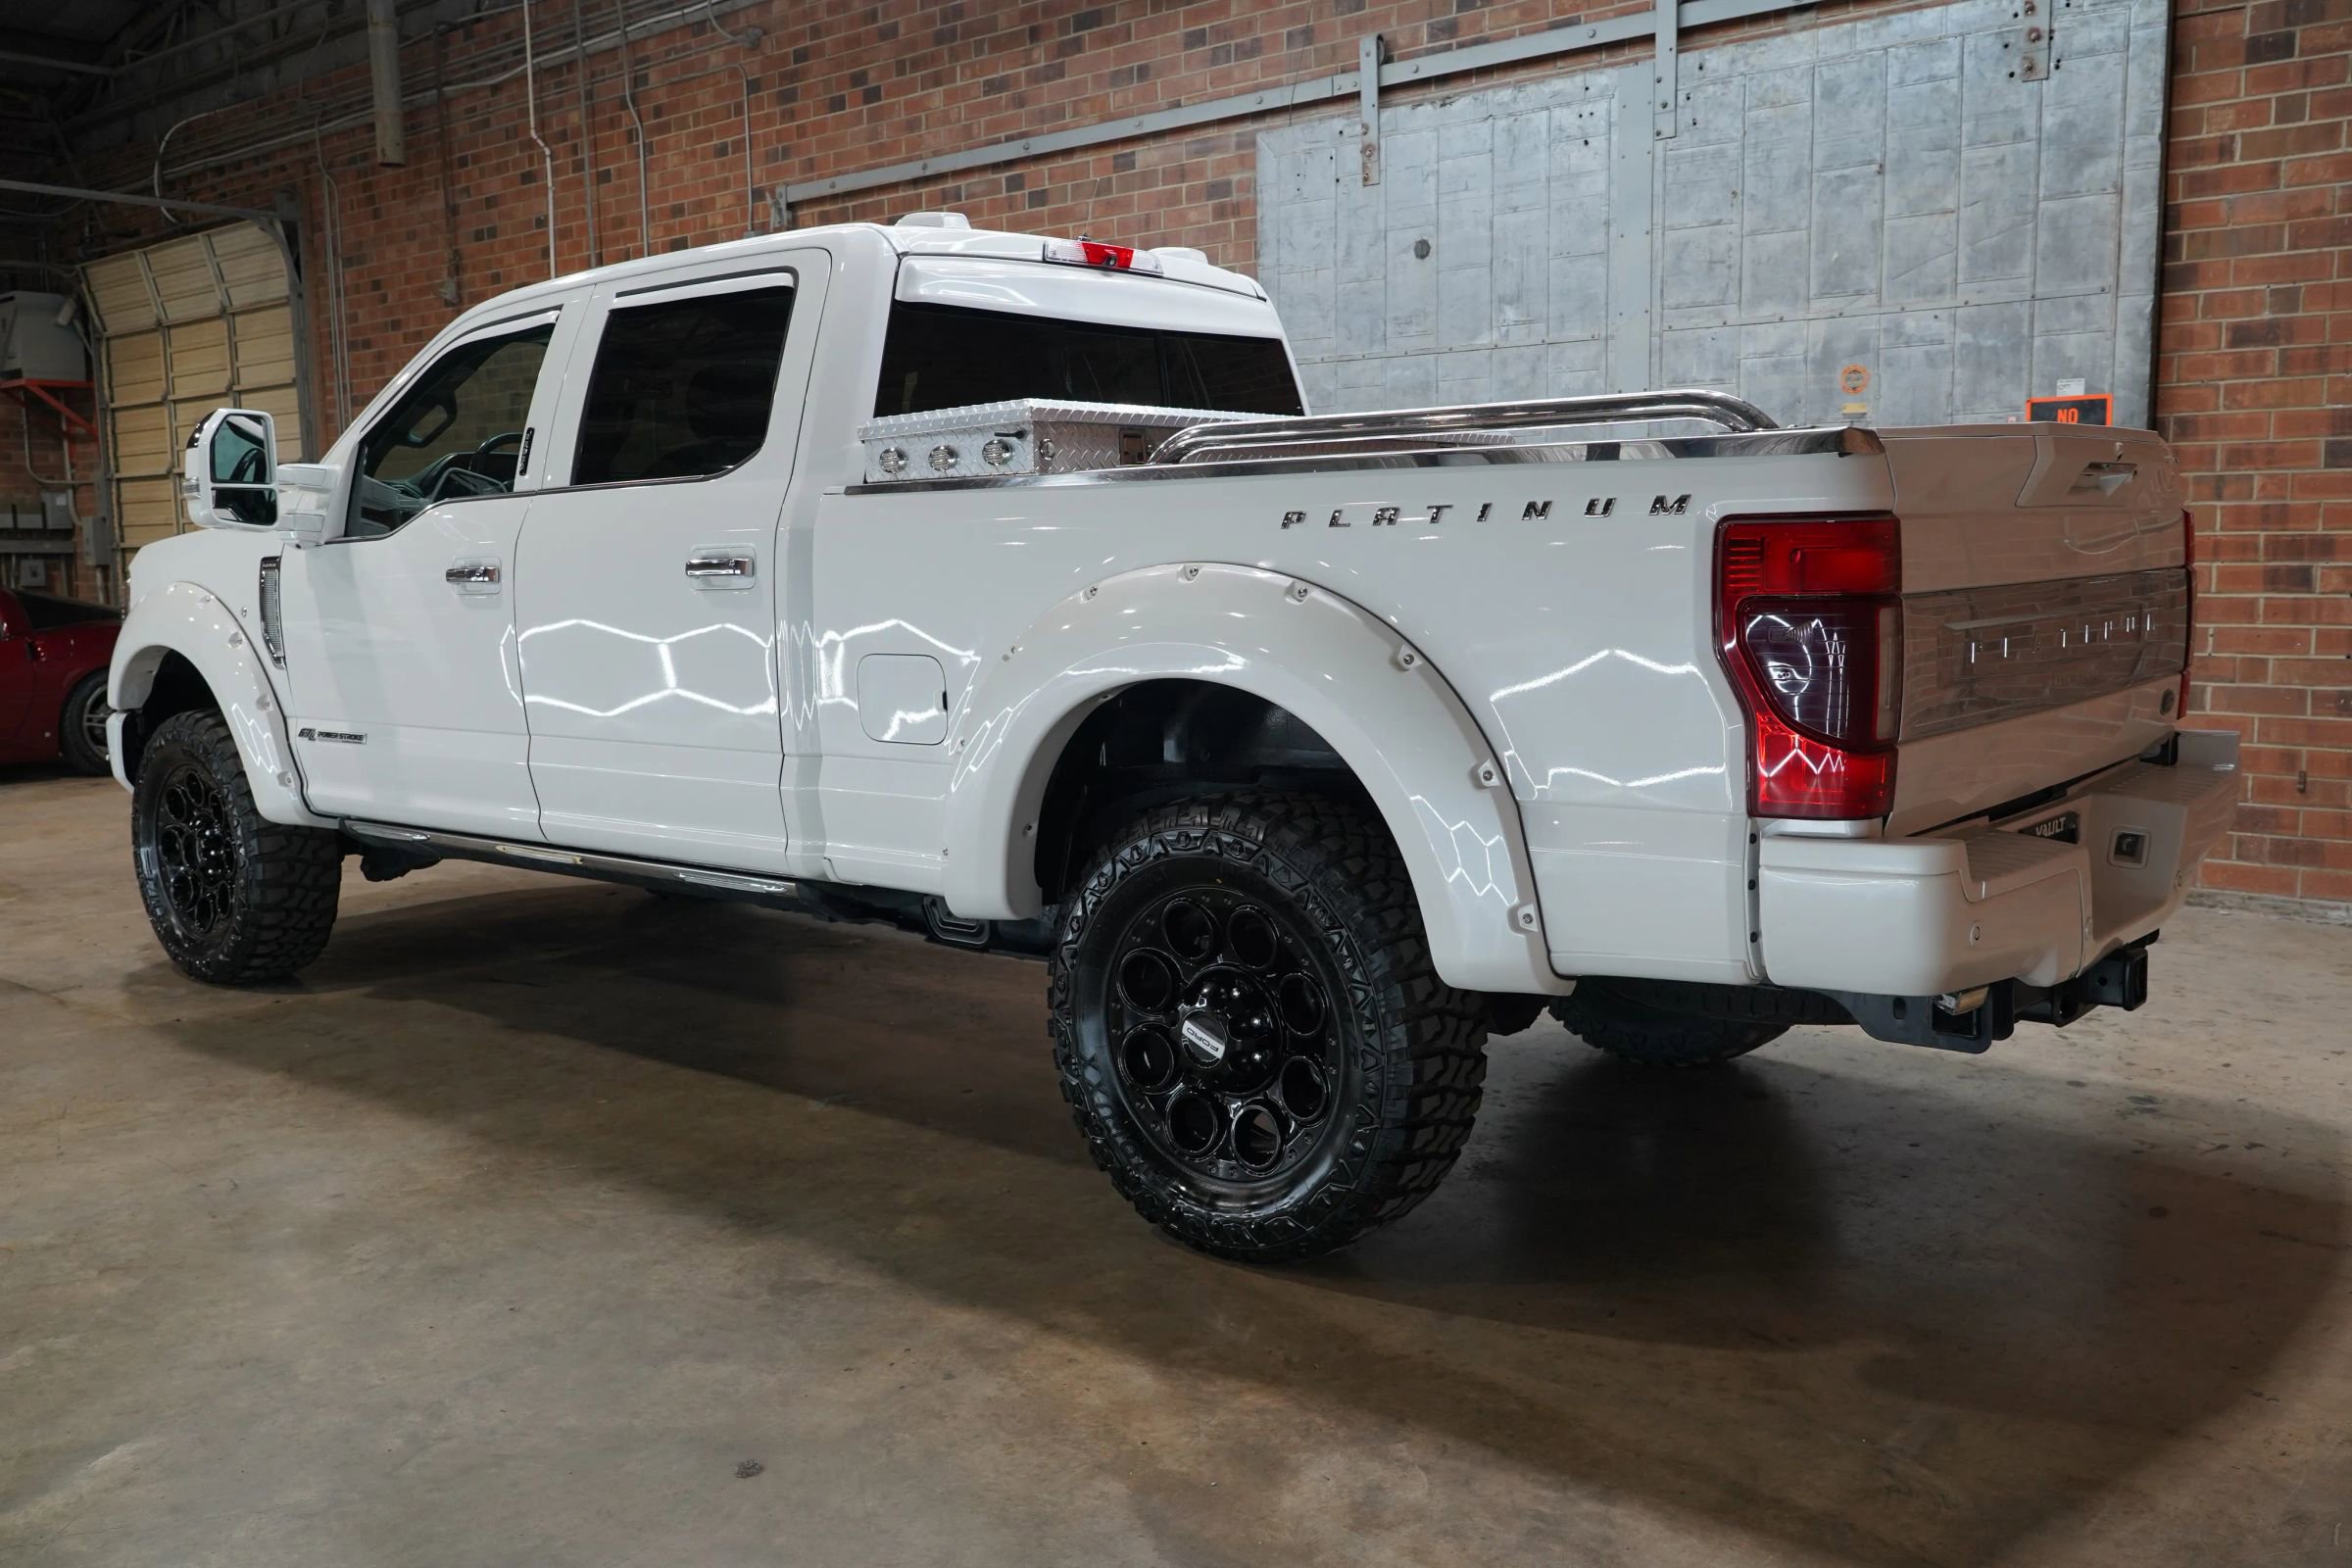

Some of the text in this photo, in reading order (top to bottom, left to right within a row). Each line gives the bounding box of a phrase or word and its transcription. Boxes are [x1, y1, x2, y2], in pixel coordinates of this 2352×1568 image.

[2057, 408, 2079, 423] NO
[1280, 494, 1691, 530] PLATINUM
[2035, 816, 2067, 838] VAULT
[1186, 1027, 1219, 1053] FORD
